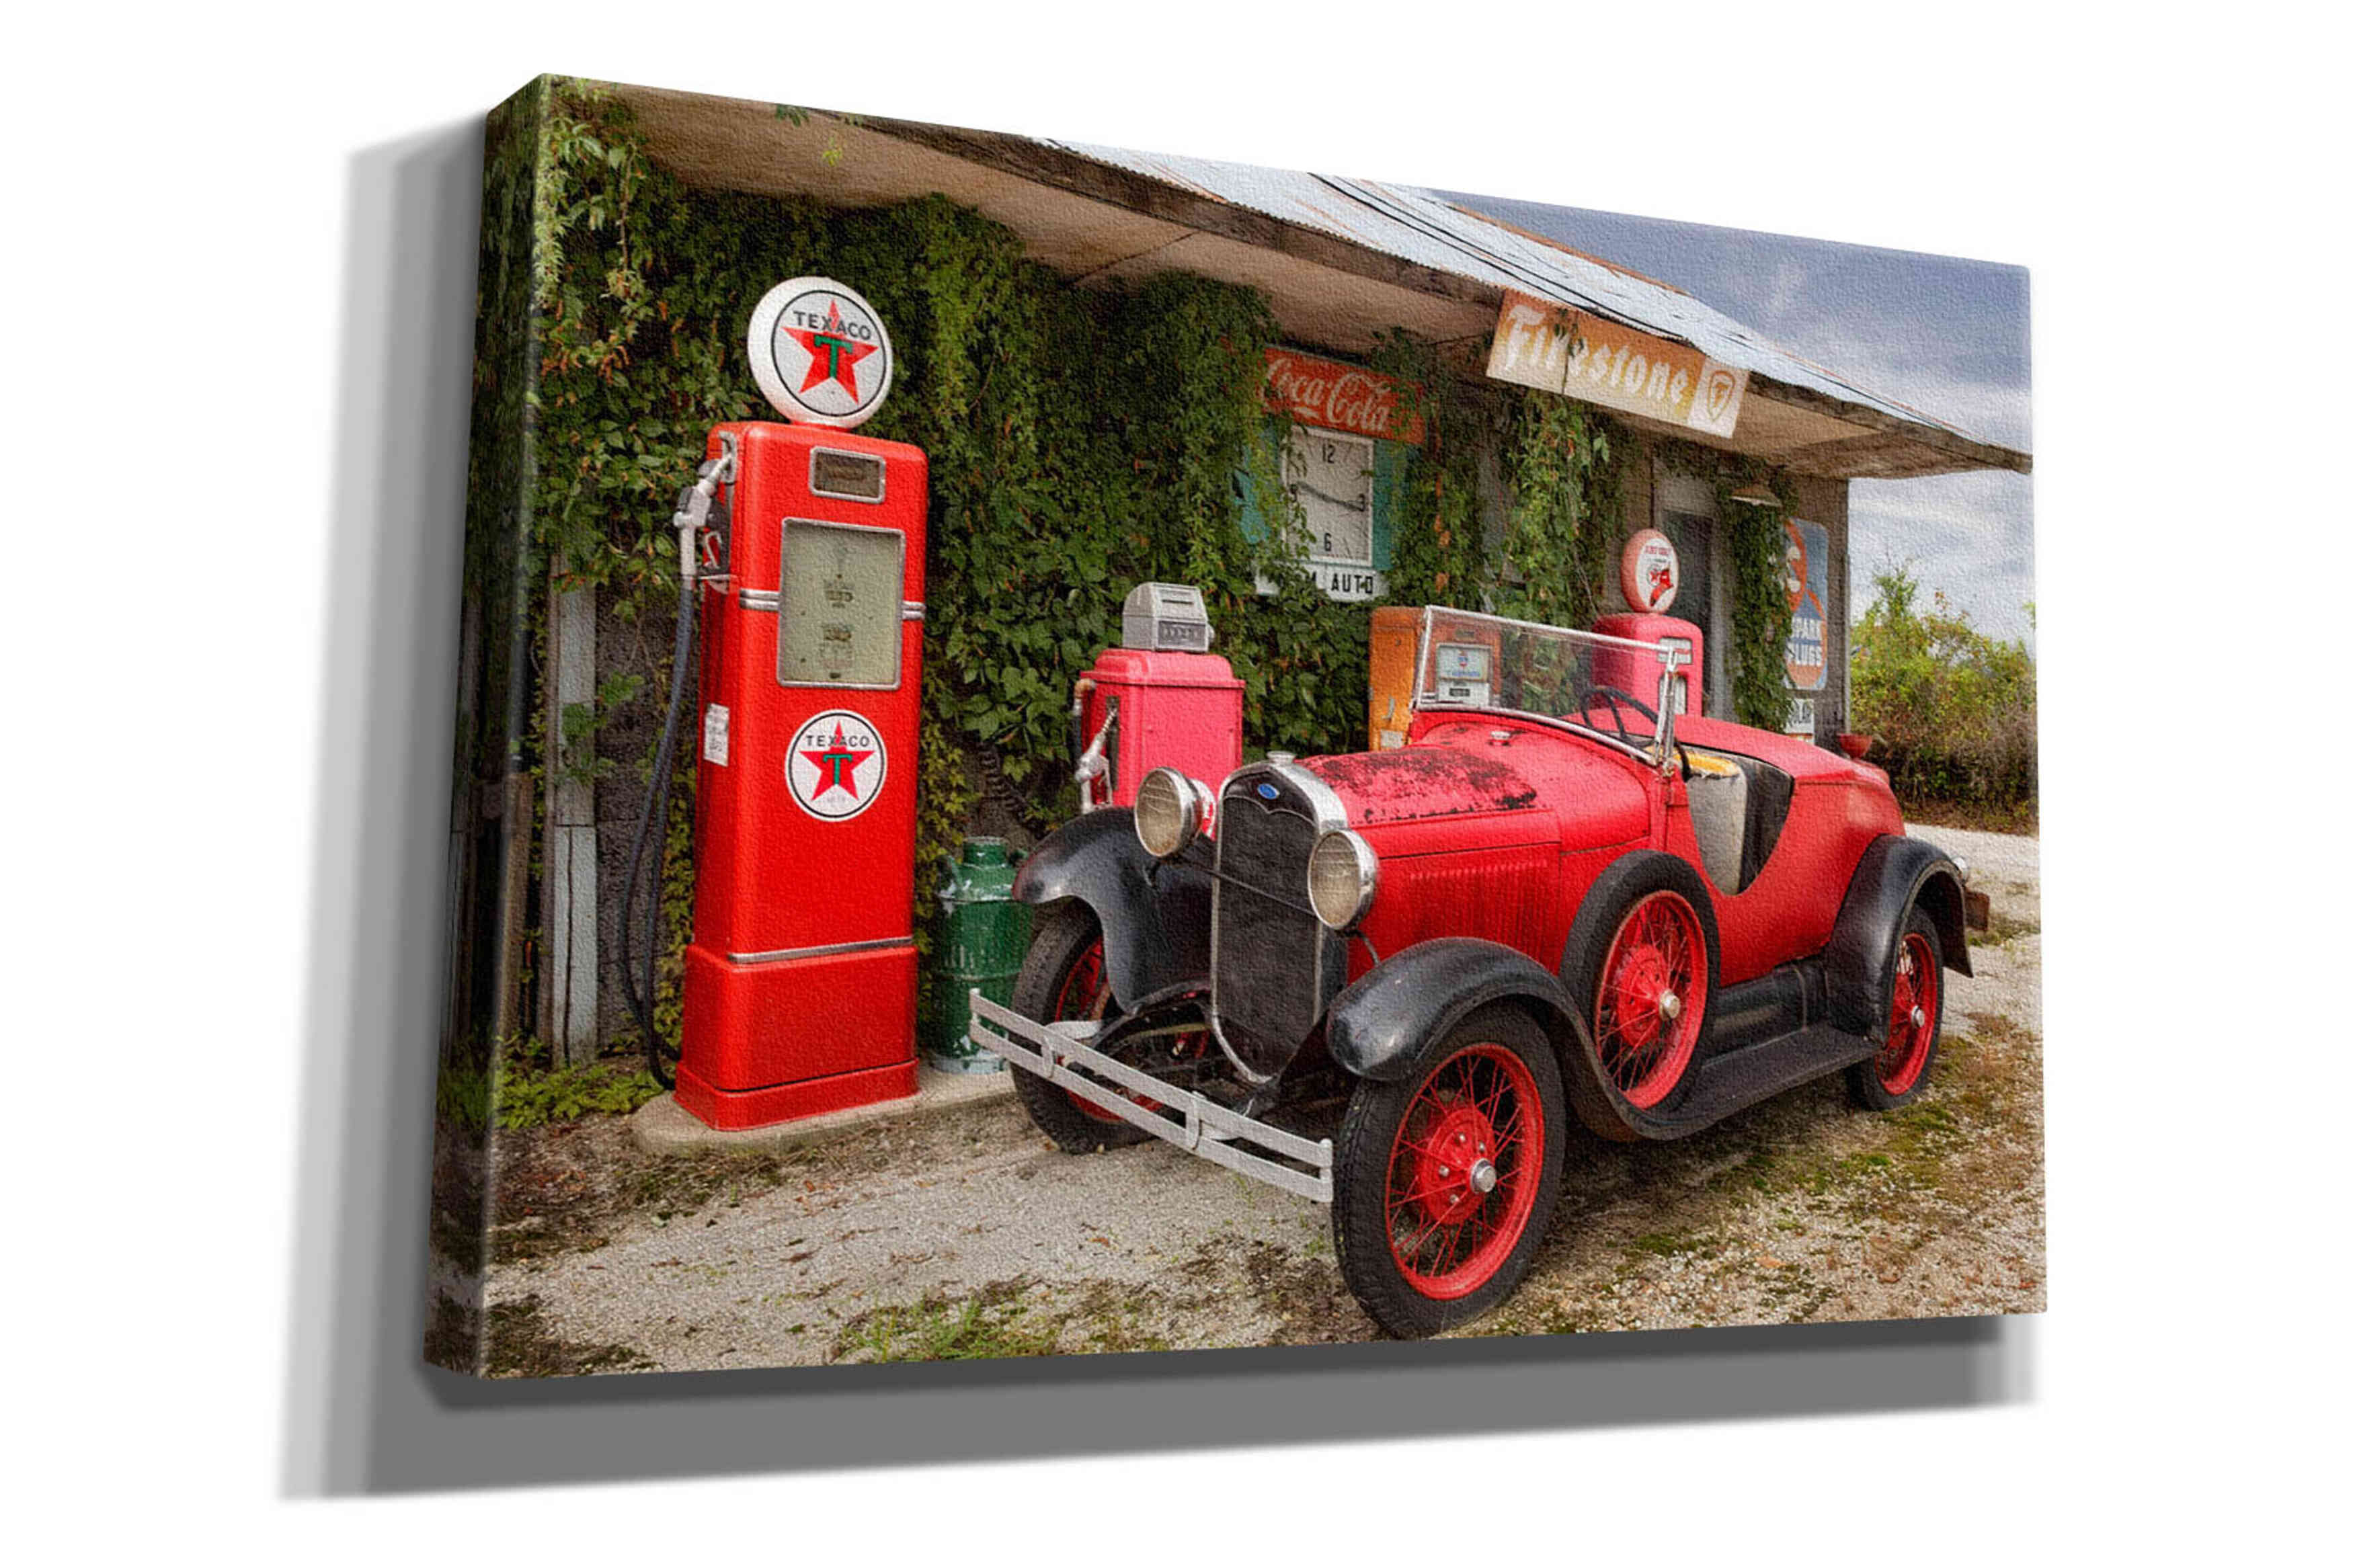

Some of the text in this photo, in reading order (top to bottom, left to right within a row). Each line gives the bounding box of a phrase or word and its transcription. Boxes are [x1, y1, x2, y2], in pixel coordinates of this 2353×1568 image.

[793, 310, 872, 341] TEXACO
[813, 335, 853, 378] T
[1322, 443, 1336, 464] 12
[1289, 483, 1298, 503] 9
[1323, 532, 1332, 552] 6
[1330, 573, 1373, 594] AUTO
[806, 735, 871, 747] TEXACO
[823, 753, 853, 786] T
